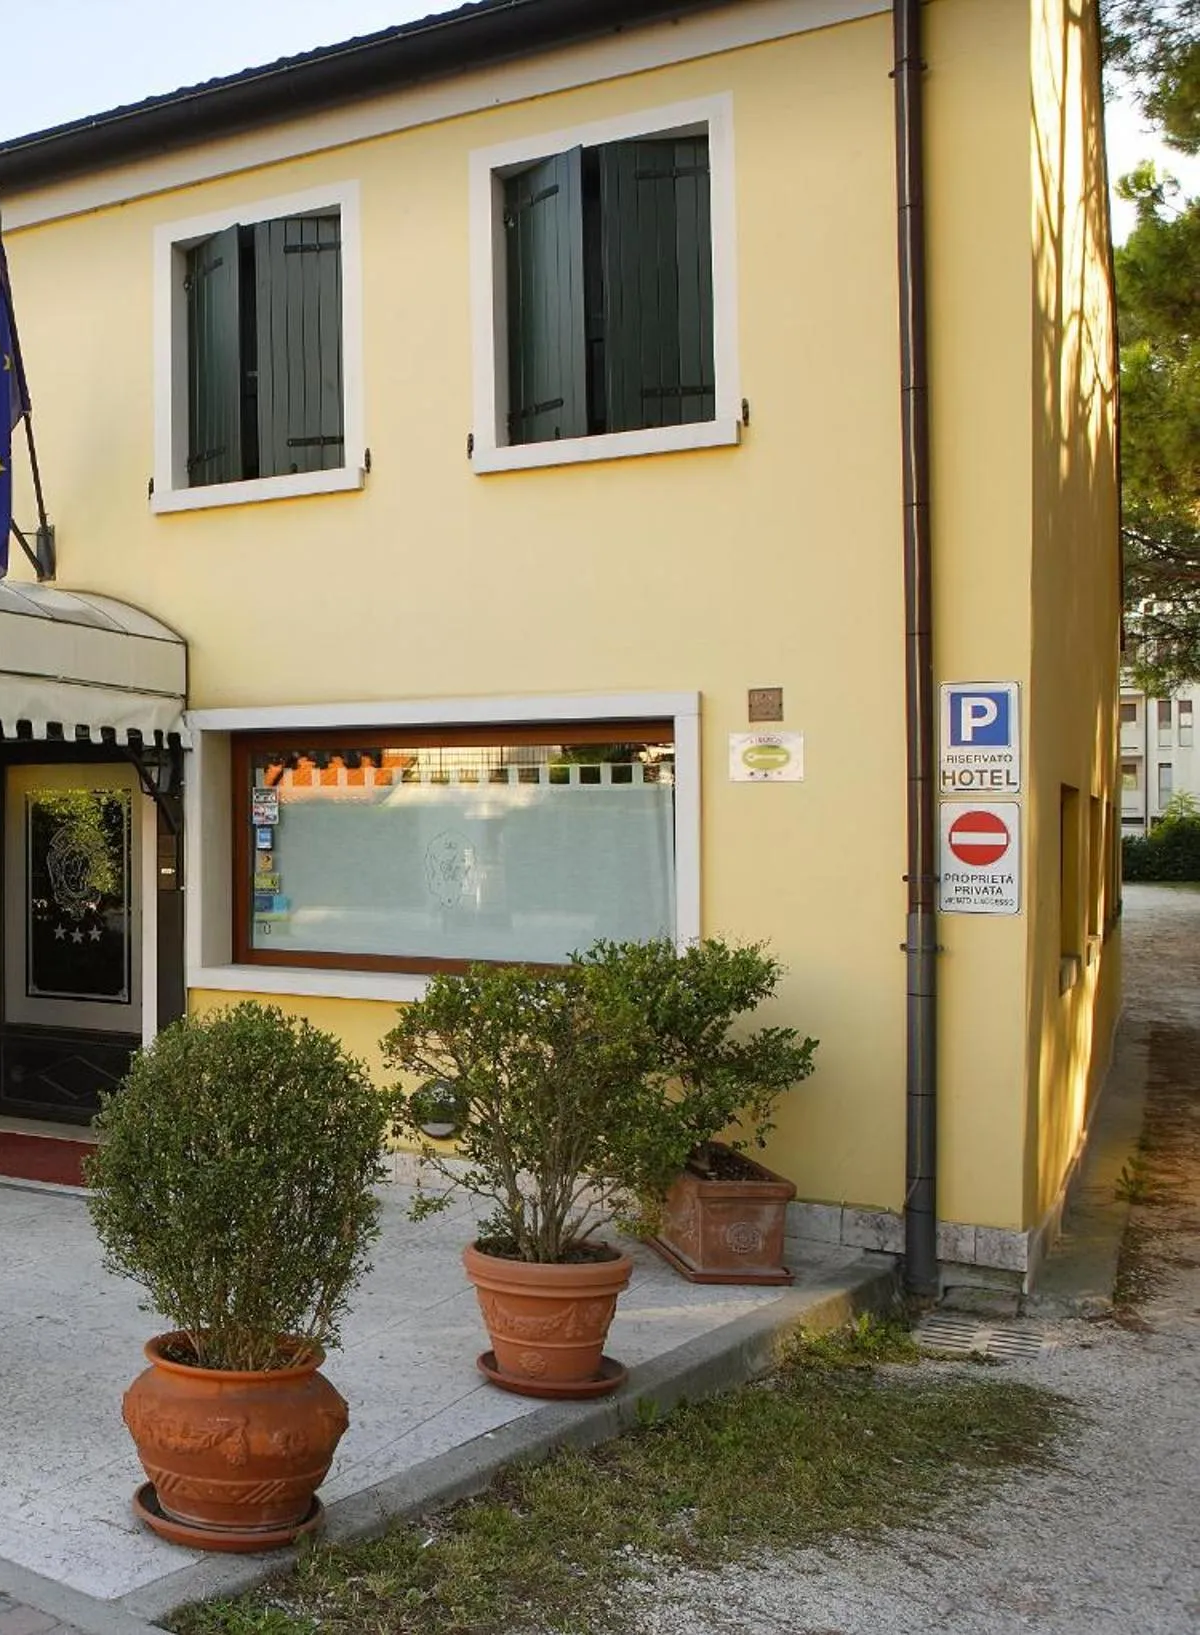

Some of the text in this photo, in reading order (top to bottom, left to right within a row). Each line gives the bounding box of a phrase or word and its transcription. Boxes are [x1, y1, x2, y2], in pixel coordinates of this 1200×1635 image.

[960, 697, 998, 742] P
[946, 754, 1013, 764] RISERVATO
[942, 769, 1018, 786] HOTEL
[954, 885, 1004, 896] PRIVATA
